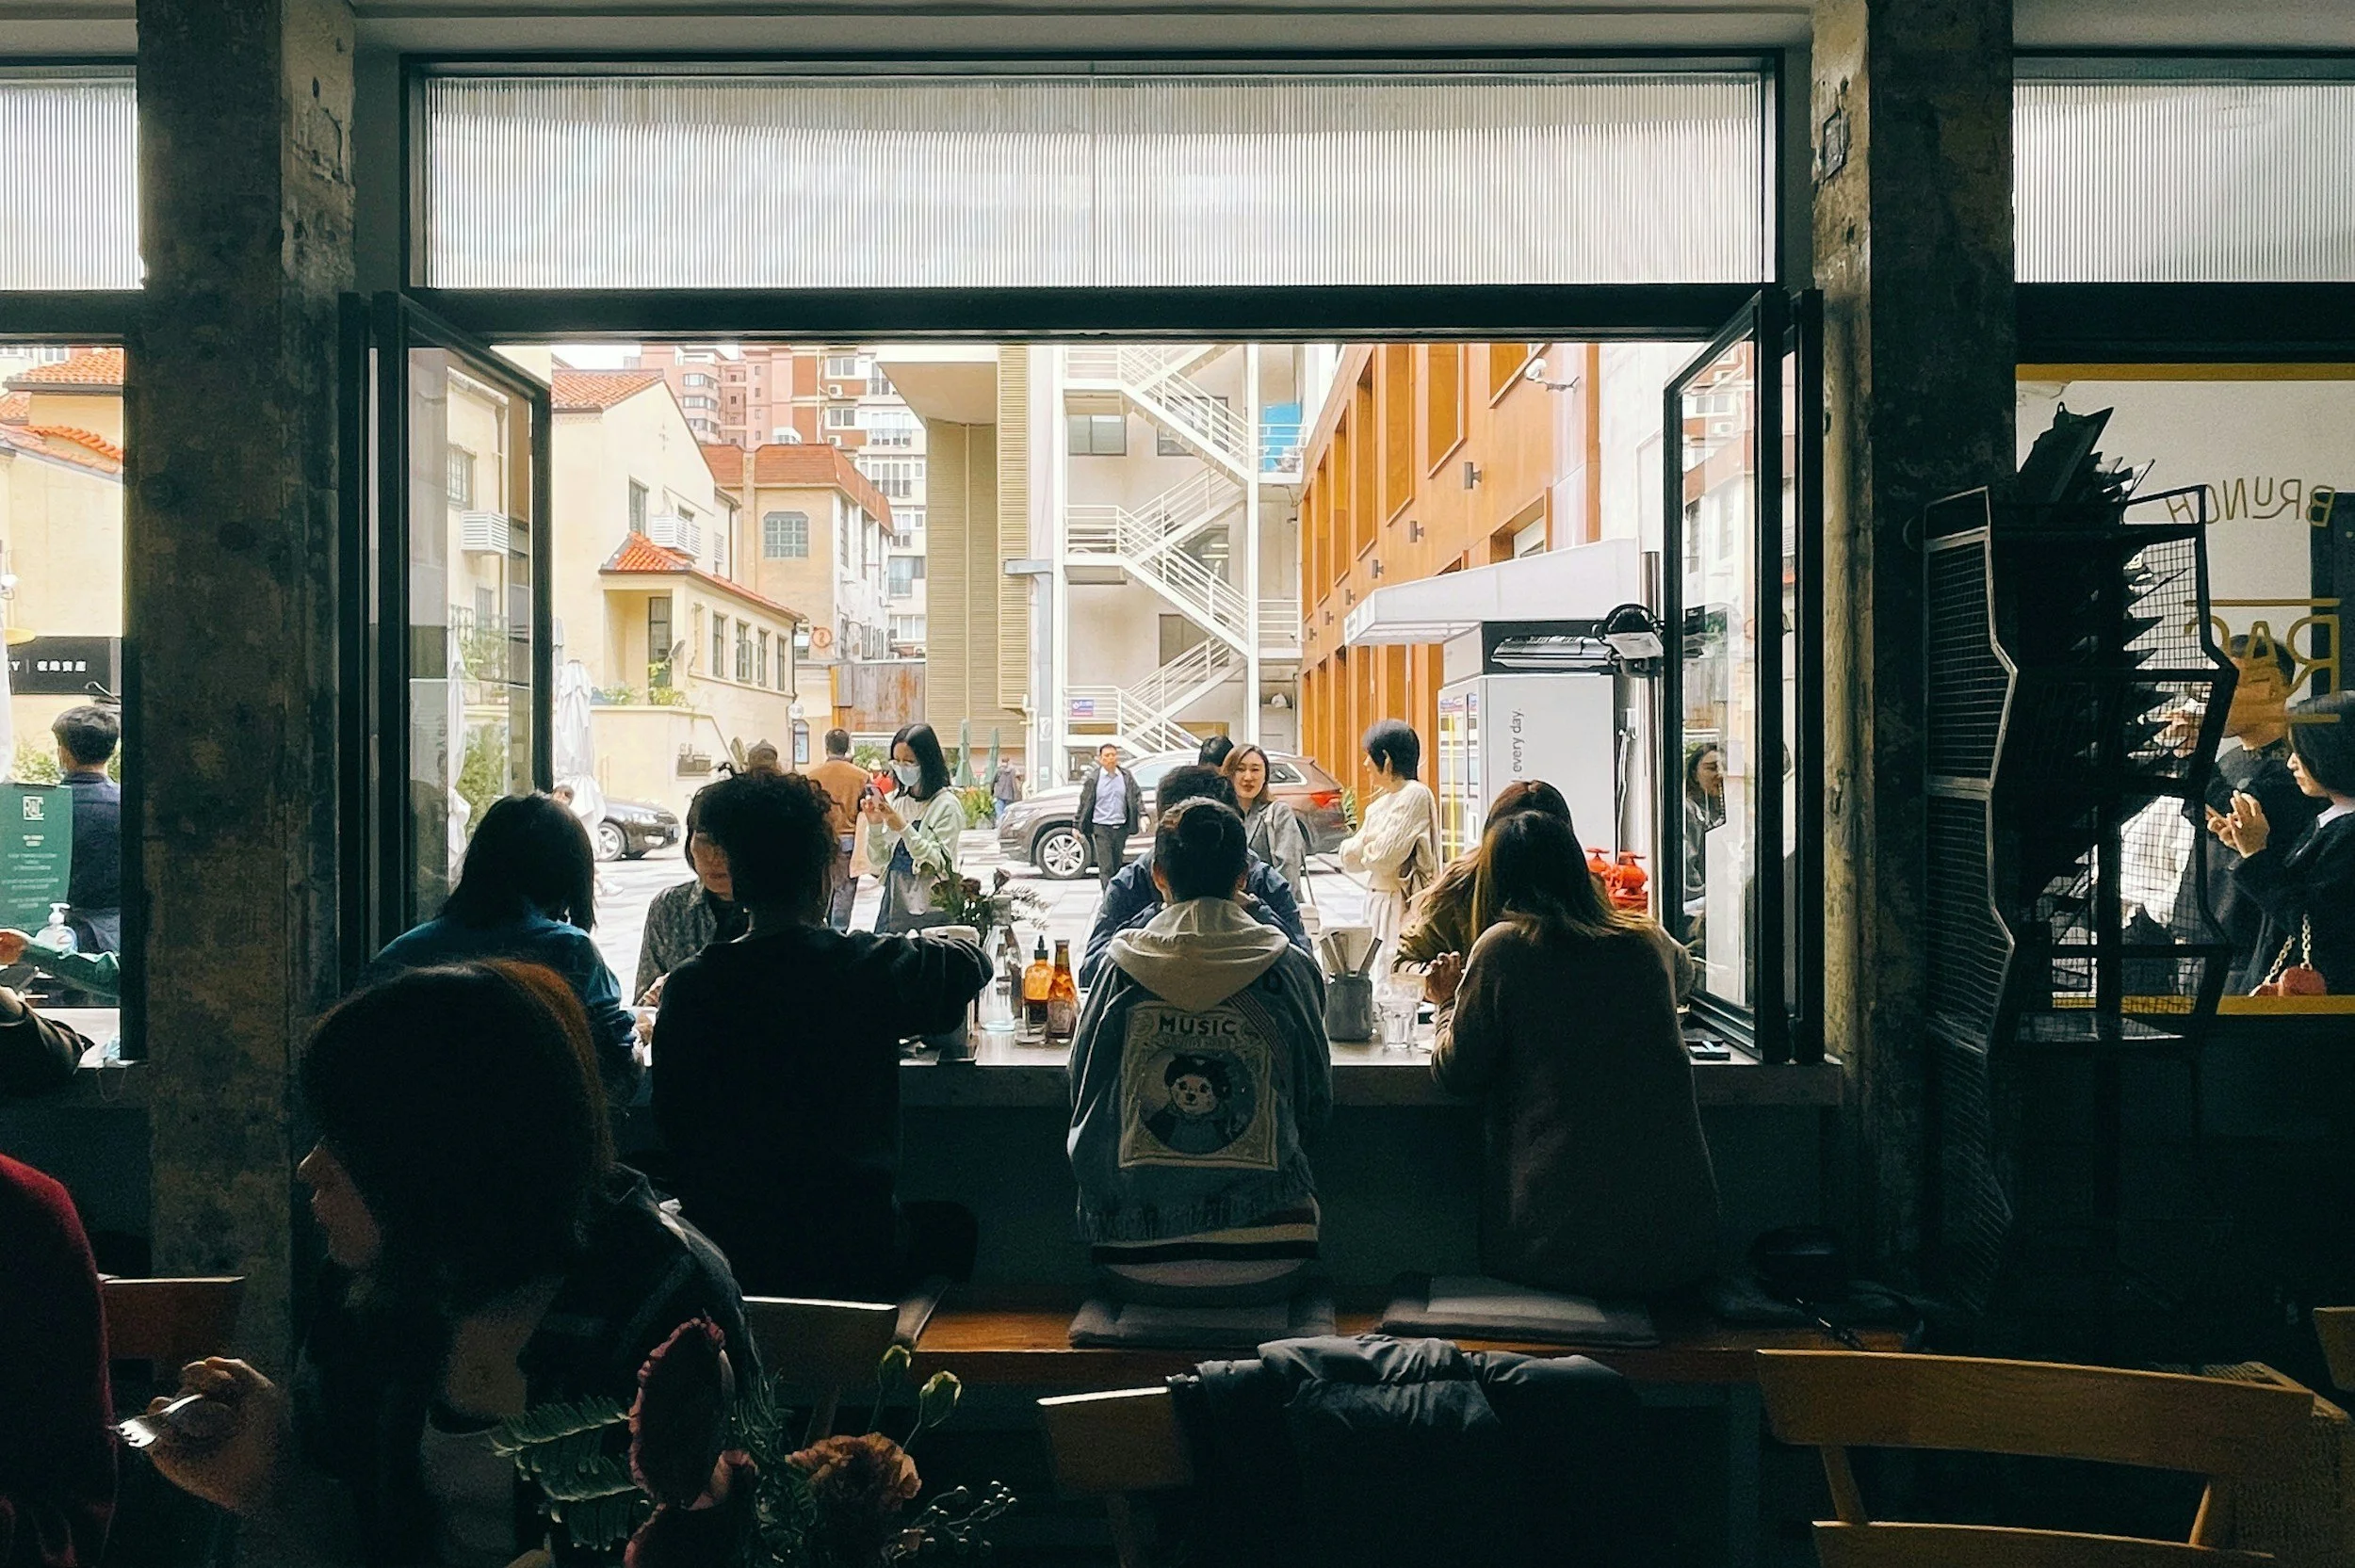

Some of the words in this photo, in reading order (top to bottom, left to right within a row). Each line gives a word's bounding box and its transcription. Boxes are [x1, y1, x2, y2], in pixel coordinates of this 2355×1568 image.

[1509, 708, 1524, 734] day.
[1512, 736, 1525, 772] every
[1158, 1014, 1238, 1035] MUSIC
